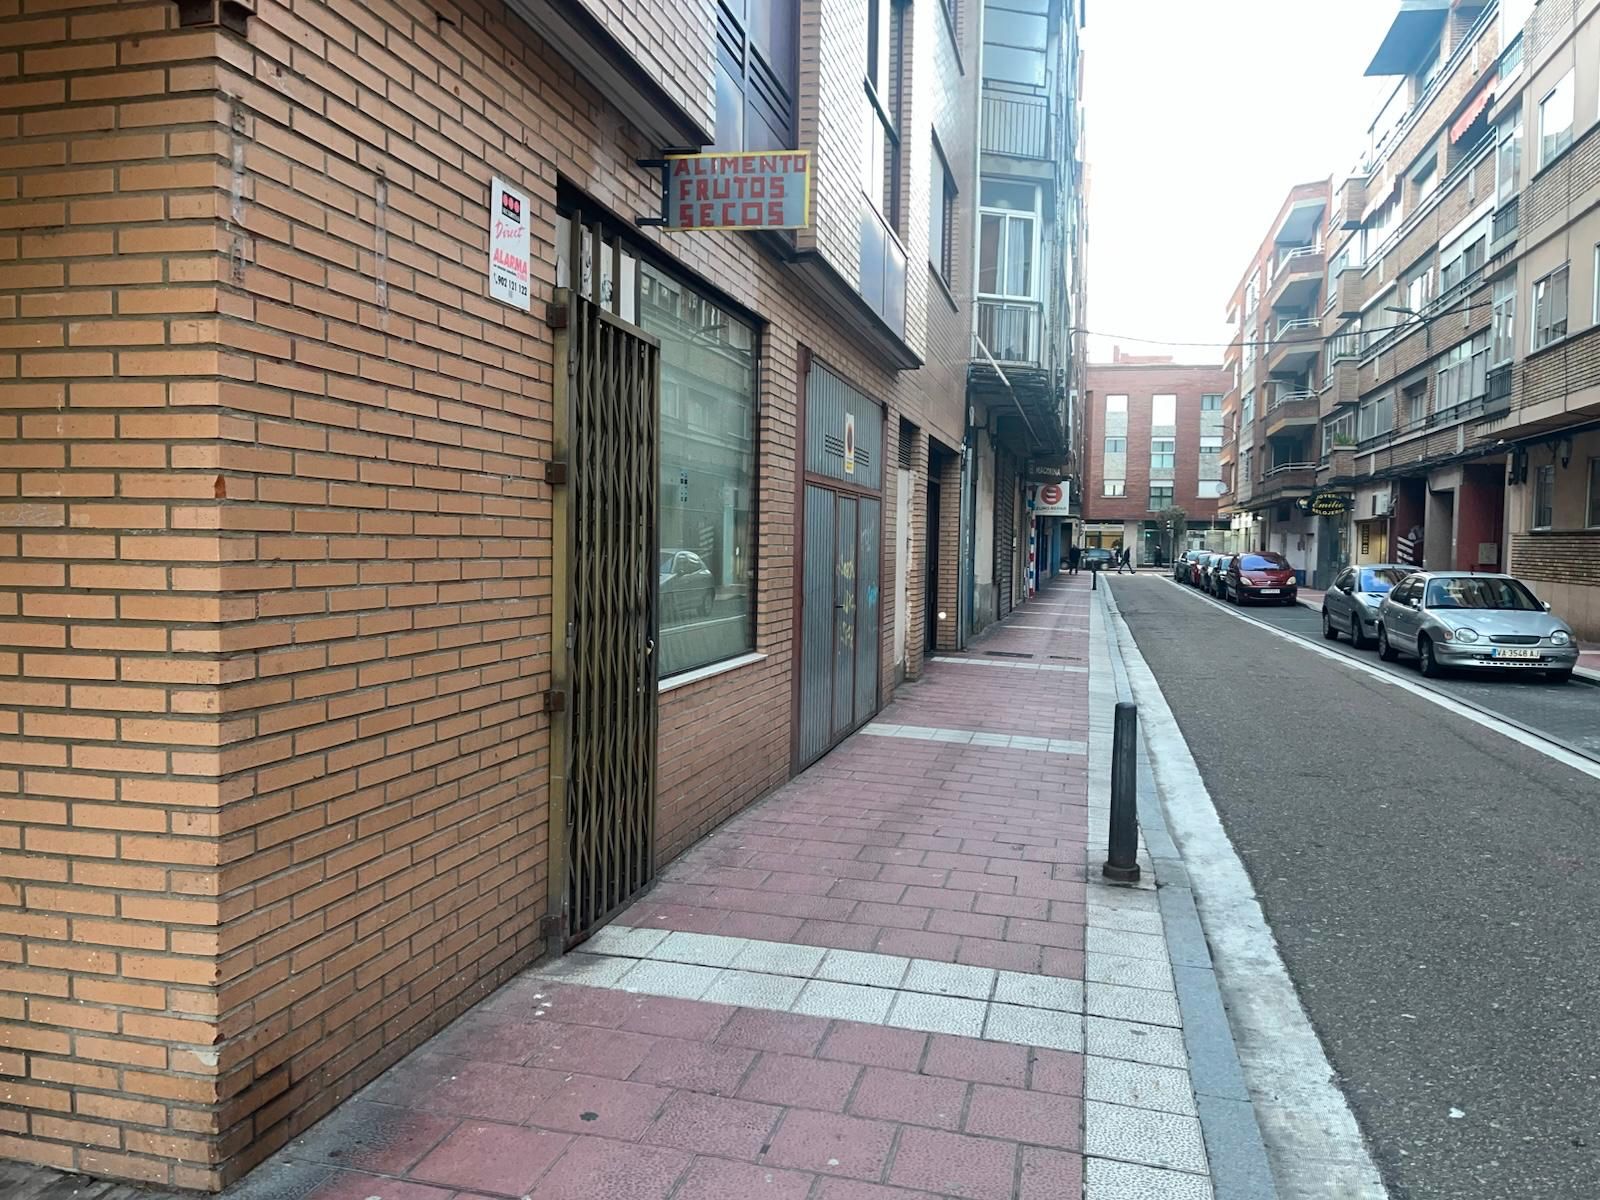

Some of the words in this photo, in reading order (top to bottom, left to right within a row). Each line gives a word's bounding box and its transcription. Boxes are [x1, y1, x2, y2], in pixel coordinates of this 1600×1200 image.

[674, 155, 806, 176] ALIMENTO
[680, 176, 785, 200] FRUTOS
[680, 201, 784, 228] SECOS
[495, 221, 525, 240] Direct
[493, 248, 528, 275] ALARMA
[497, 275, 507, 288] 902
[508, 279, 517, 292] 121
[518, 283, 528, 296] 122
[1312, 499, 1344, 508] Emilio
